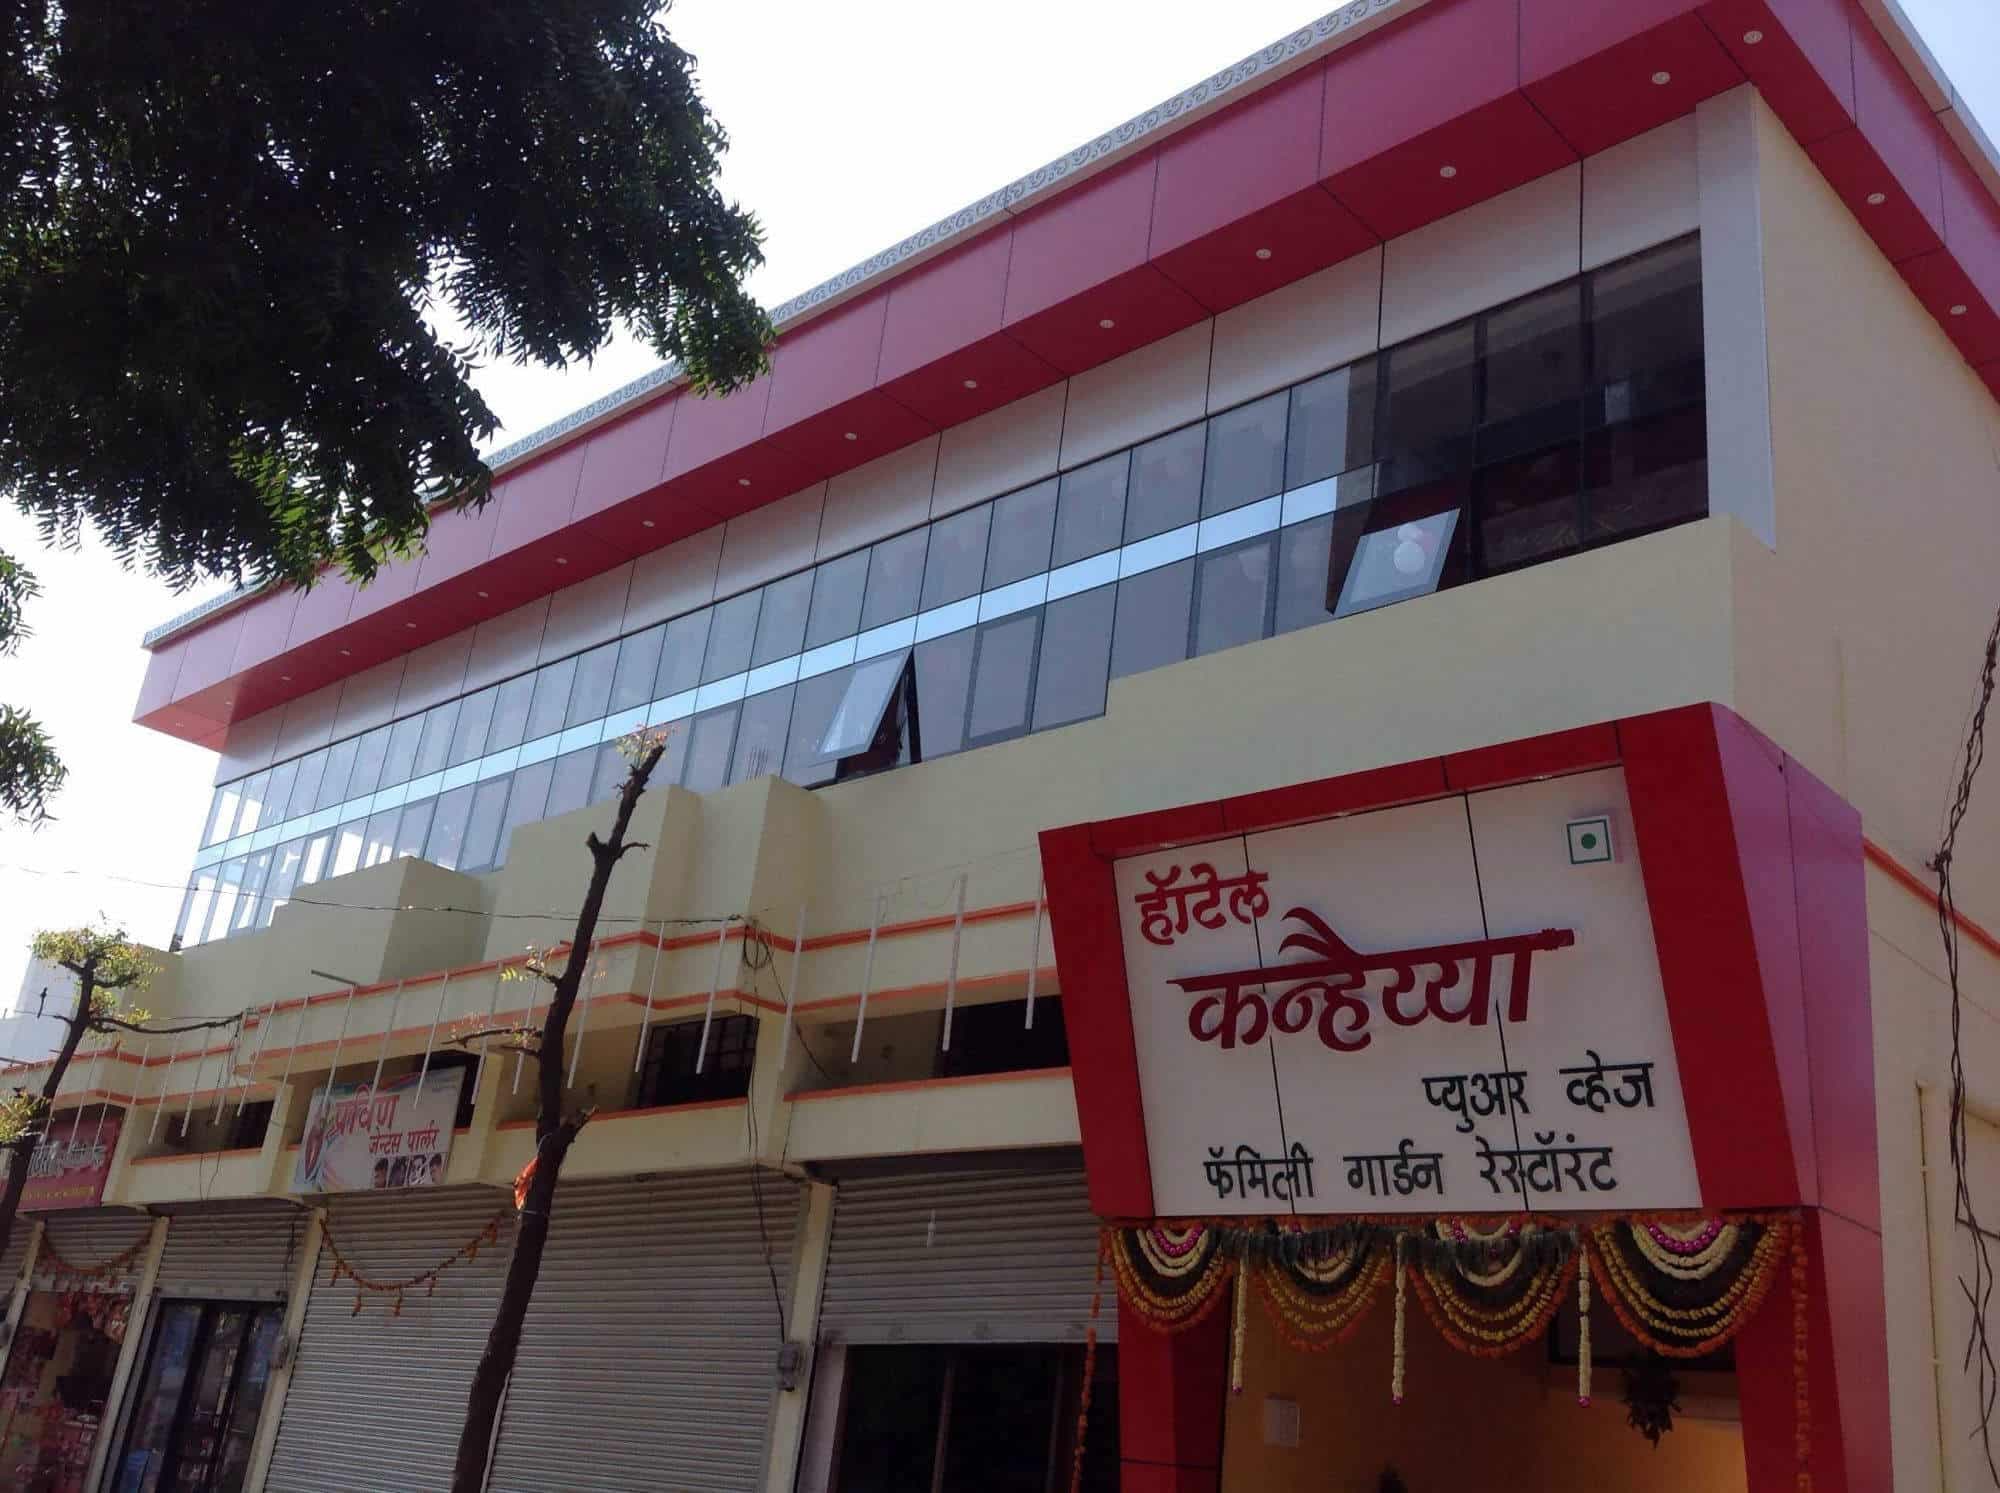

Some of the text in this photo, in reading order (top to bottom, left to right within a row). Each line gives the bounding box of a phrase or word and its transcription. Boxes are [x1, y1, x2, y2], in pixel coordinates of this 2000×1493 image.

[1134, 862, 1269, 946] हॉटेल
[1166, 906, 1576, 1053] कन्हैय्या
[1421, 1049, 1656, 1134] प्युअर व्हेज
[1202, 1131, 1619, 1201] फॅमिली गार्डन रेस्टॉरंट
